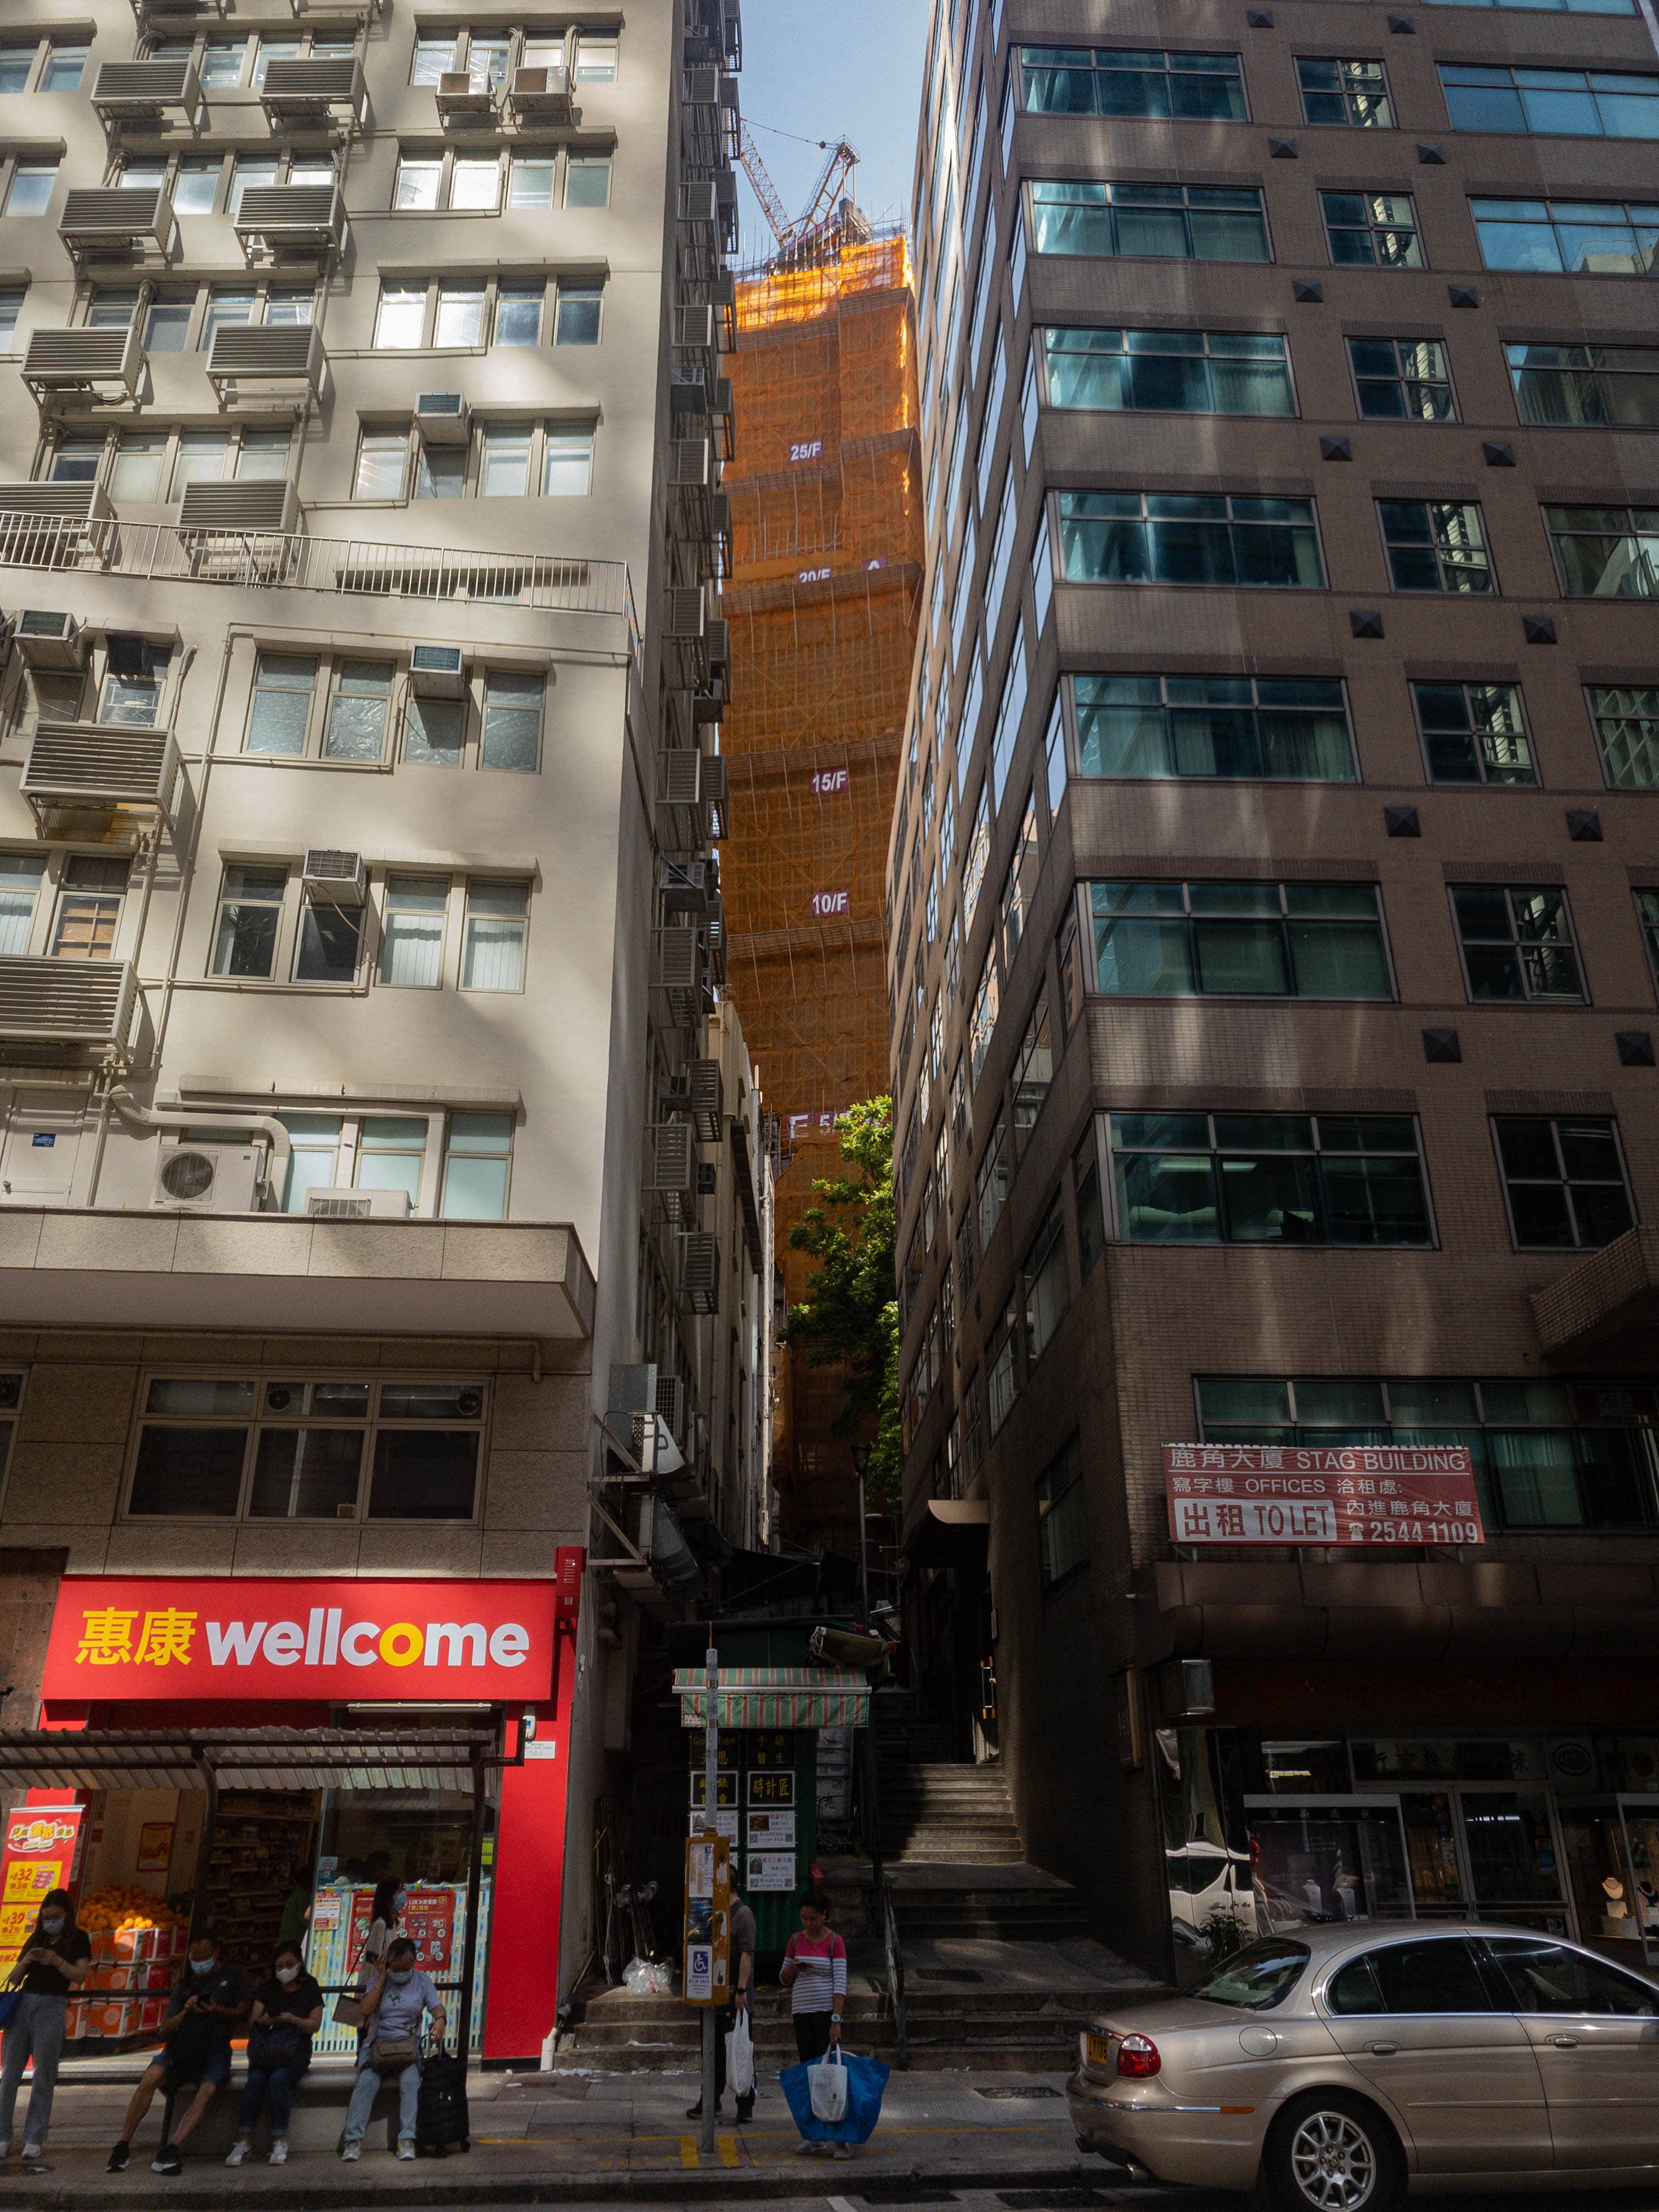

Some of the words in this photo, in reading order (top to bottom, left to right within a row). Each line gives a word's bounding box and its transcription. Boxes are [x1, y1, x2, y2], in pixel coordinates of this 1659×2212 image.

[790, 441, 822, 461] 25/F
[812, 770, 847, 793] 15/F
[812, 892, 847, 914] 10/F
[1171, 1449, 1285, 1469] 鹿角大廈
[1297, 1451, 1356, 1470] STAG
[1363, 1452, 1465, 1471] BUILDING
[1172, 1477, 1234, 1493] 寫字樓
[1245, 1479, 1325, 1493] OFFICES
[1183, 1503, 1246, 1537] 出租
[1370, 1521, 1423, 1542] 2544
[1428, 1522, 1478, 1543] 1109
[74, 1607, 199, 1666] 惠康
[205, 1607, 529, 1667] wellcome
[752, 1777, 791, 1799] 時計匠
